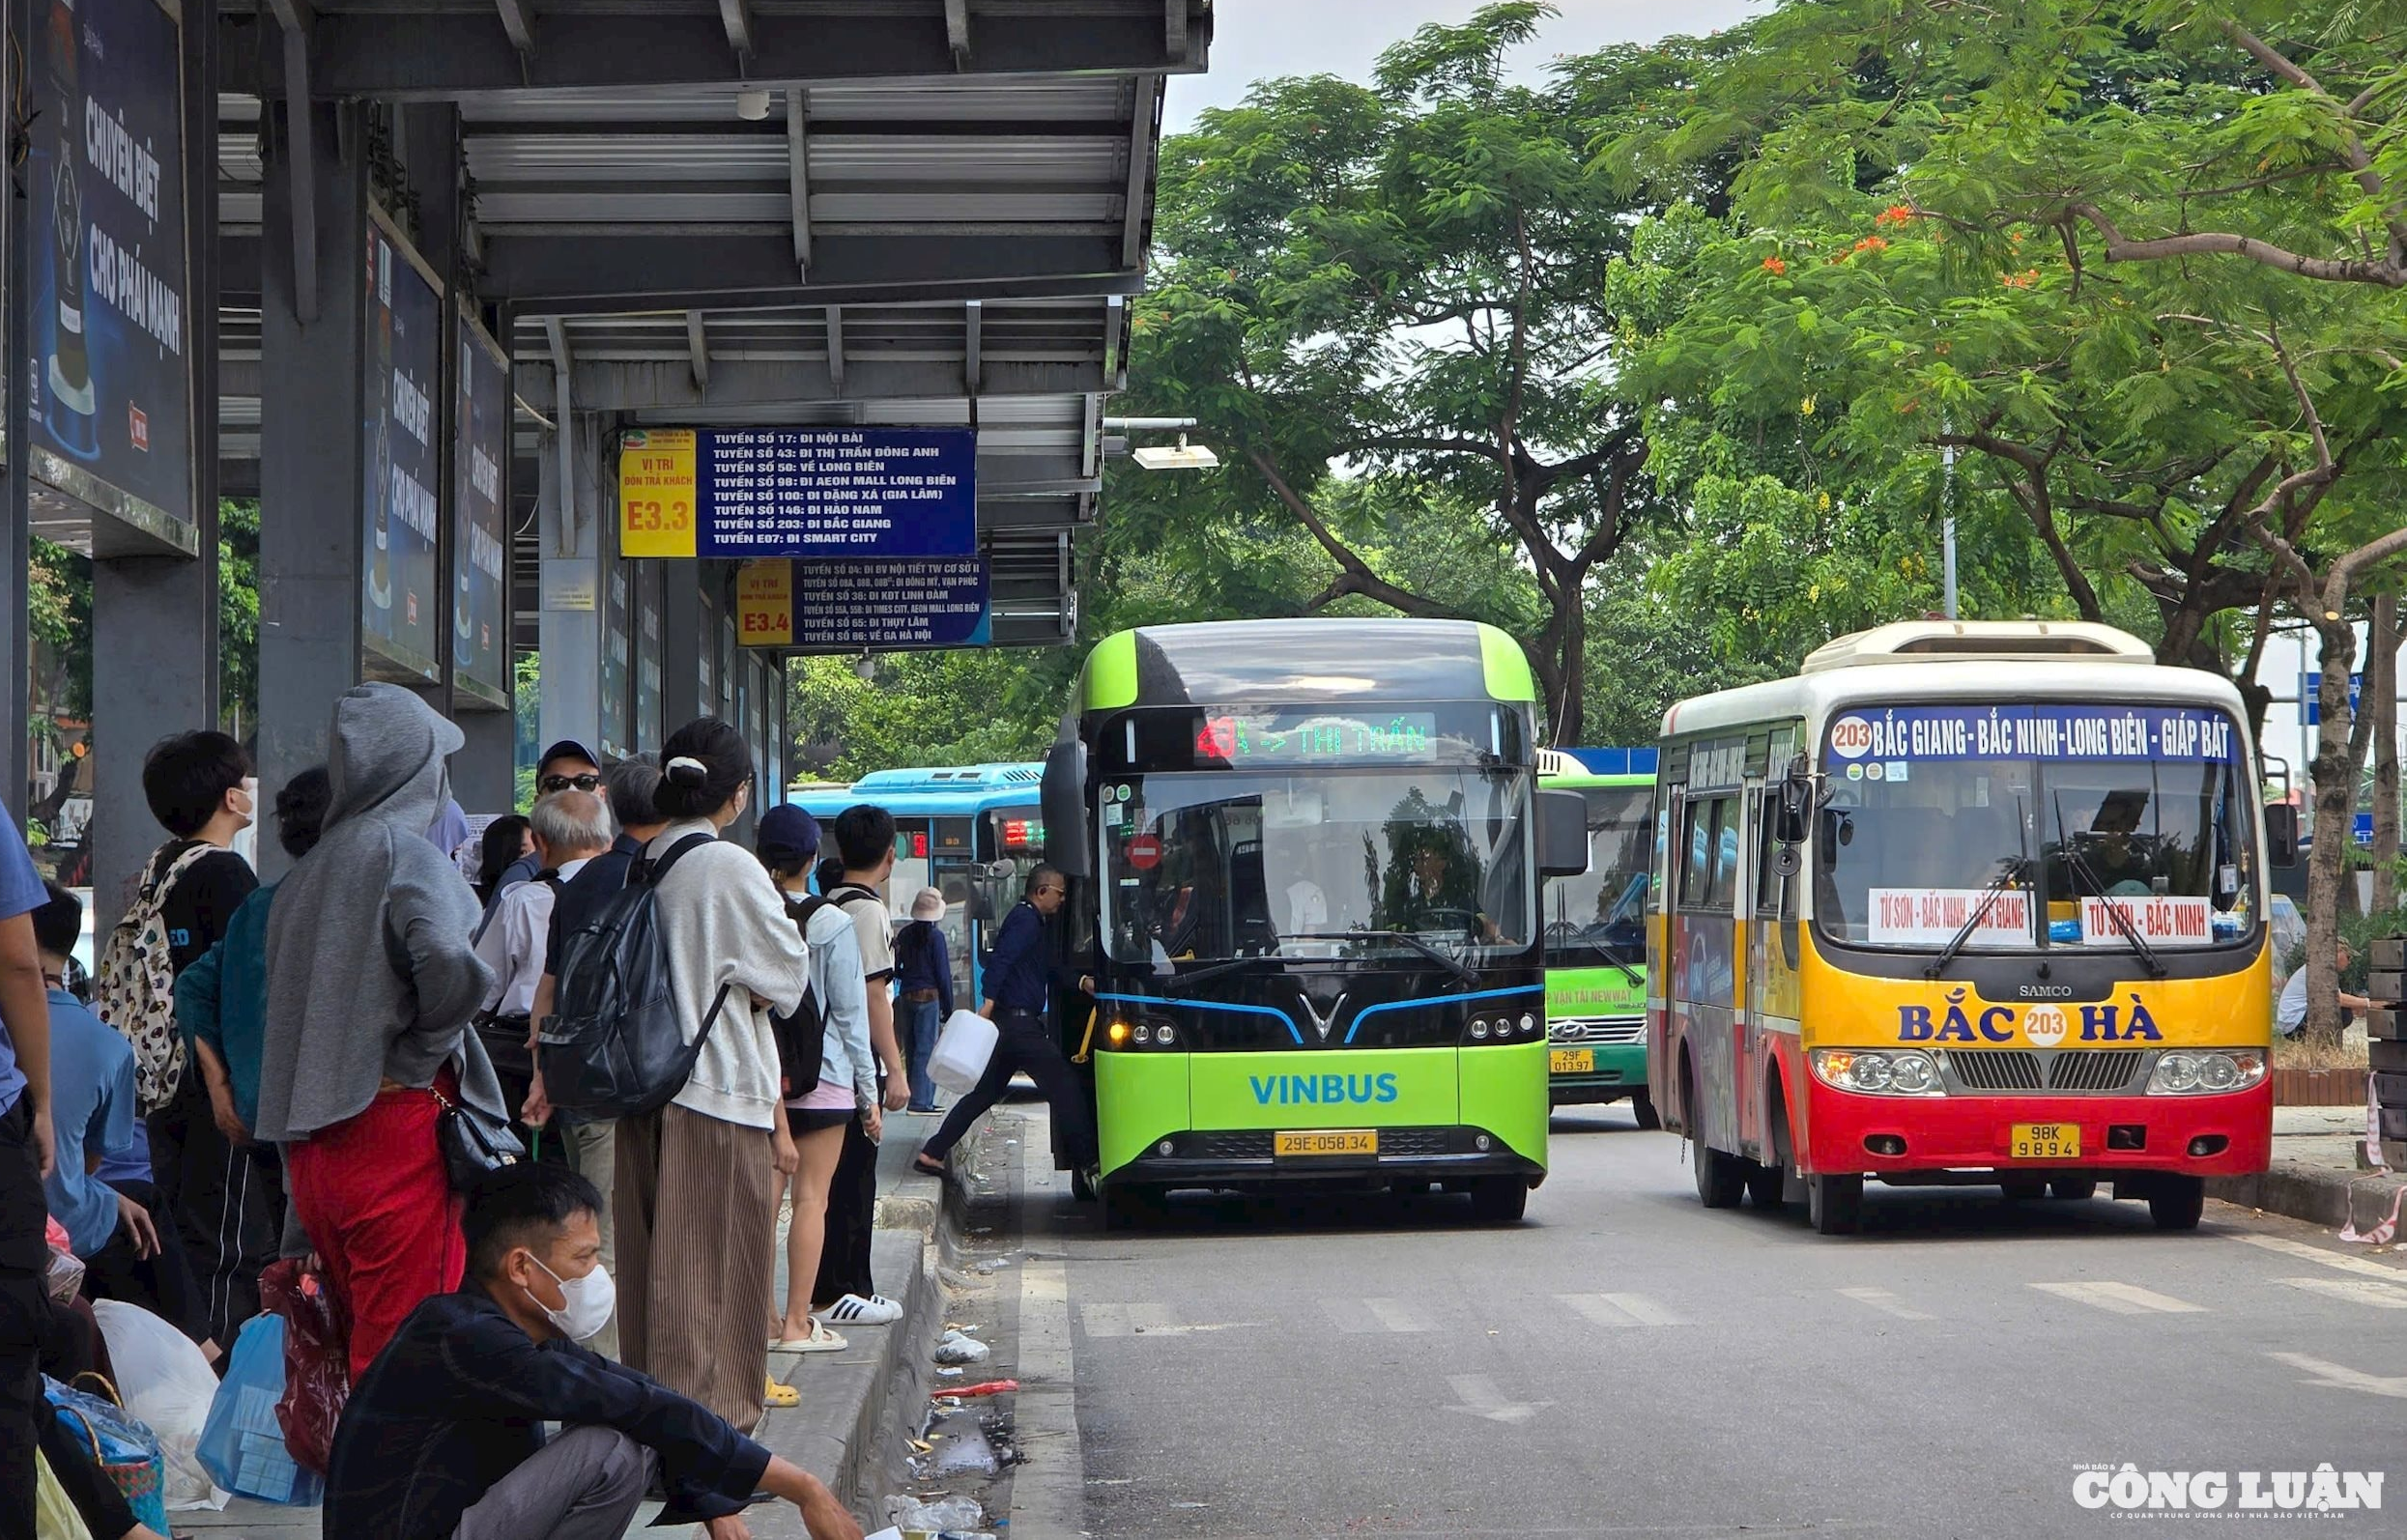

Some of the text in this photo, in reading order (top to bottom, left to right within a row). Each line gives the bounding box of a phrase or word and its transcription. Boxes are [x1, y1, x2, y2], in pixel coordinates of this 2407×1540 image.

[86, 95, 133, 201] CHUYÊN
[135, 136, 159, 236] BIỆT
[90, 223, 181, 360] CHO PHÁI MẠNH
[715, 432, 863, 444] TUYẾN SỐ 17: ĐI NỘI BÀI
[714, 446, 754, 458] TUYẾN
[757, 446, 773, 458] SỐ
[777, 449, 796, 458] 43:
[816, 448, 835, 459] THỊ
[839, 445, 871, 457] TRẤN
[874, 446, 909, 456] ĐÔNG
[913, 447, 939, 456] ANH
[643, 458, 653, 473] VỊ
[715, 460, 754, 472] TUYẾN
[758, 460, 774, 471] SỐ
[819, 463, 851, 471] LONG
[855, 460, 884, 471] BIÊN
[714, 474, 956, 487] TUYẾN SỐ 98: ĐI AEON MALL LONG BIÊN
[714, 489, 754, 500] TUYẾN
[757, 489, 774, 500] SỐ
[778, 492, 804, 500] 100:
[823, 489, 858, 501] ĐẶNG
[882, 490, 908, 499] (GIA
[911, 488, 943, 499] LÂM)
[628, 501, 688, 530] E3.3
[715, 502, 754, 515] TUYẾN
[758, 502, 774, 515] SỐ
[778, 505, 805, 515] 146:
[808, 505, 820, 514] ĐI
[853, 505, 882, 514] NAM
[715, 516, 891, 529] TUYẾN SỐ 203: ĐI BẮC GIANG
[714, 531, 877, 543] TUYẾN E07: ĐI SMART CITY
[803, 562, 831, 575] TUYẾN
[834, 562, 846, 574] SỐ
[864, 565, 874, 574] ĐI
[875, 565, 887, 574] BV
[889, 563, 905, 576] NỘI
[908, 562, 926, 574] TIẾT
[928, 564, 942, 573] TW
[944, 563, 958, 573] CƠ
[803, 589, 834, 601] TUYẾN
[837, 588, 849, 600] SỐ
[869, 591, 878, 600] ĐI
[902, 590, 924, 600] LINH
[744, 613, 788, 631] E3.4
[804, 616, 834, 628] TUYẾN
[837, 615, 849, 627] SỐ
[870, 618, 878, 627] ĐI
[908, 615, 929, 627] LÂM
[804, 629, 834, 642] TUYẾN
[837, 629, 849, 641] SỐ
[884, 631, 897, 640] GA
[900, 629, 912, 640] HÀ
[915, 629, 931, 642] NỘI
[1353, 716, 1425, 752] TRẤN
[1835, 724, 1870, 747] 203
[1873, 708, 1907, 756] BẮC
[2110, 711, 2148, 756] BIÊN
[2163, 712, 2197, 756] GIÁP
[2201, 715, 2228, 758] BÁT
[1879, 891, 1892, 928] TỪ
[1894, 894, 1913, 928] SƠN
[1922, 890, 1940, 928] BẮC
[1943, 897, 1965, 928] NINH
[1996, 897, 2024, 928] GIANG
[2089, 899, 2105, 936] TỪ
[2146, 898, 2171, 936] BẮC
[2175, 904, 2205, 936] NINH
[1591, 988, 1631, 1003] NEWWAY
[2020, 986, 2072, 997] SAMCO
[1898, 987, 2163, 1041] BẮC 203 HÀ
[1562, 1050, 1581, 1061] 29F
[1555, 1062, 1590, 1071] 013.97
[1248, 1072, 1398, 1104] VINBUS
[2032, 1126, 2060, 1140] 98K
[1284, 1136, 1368, 1151] 29E-058.34
